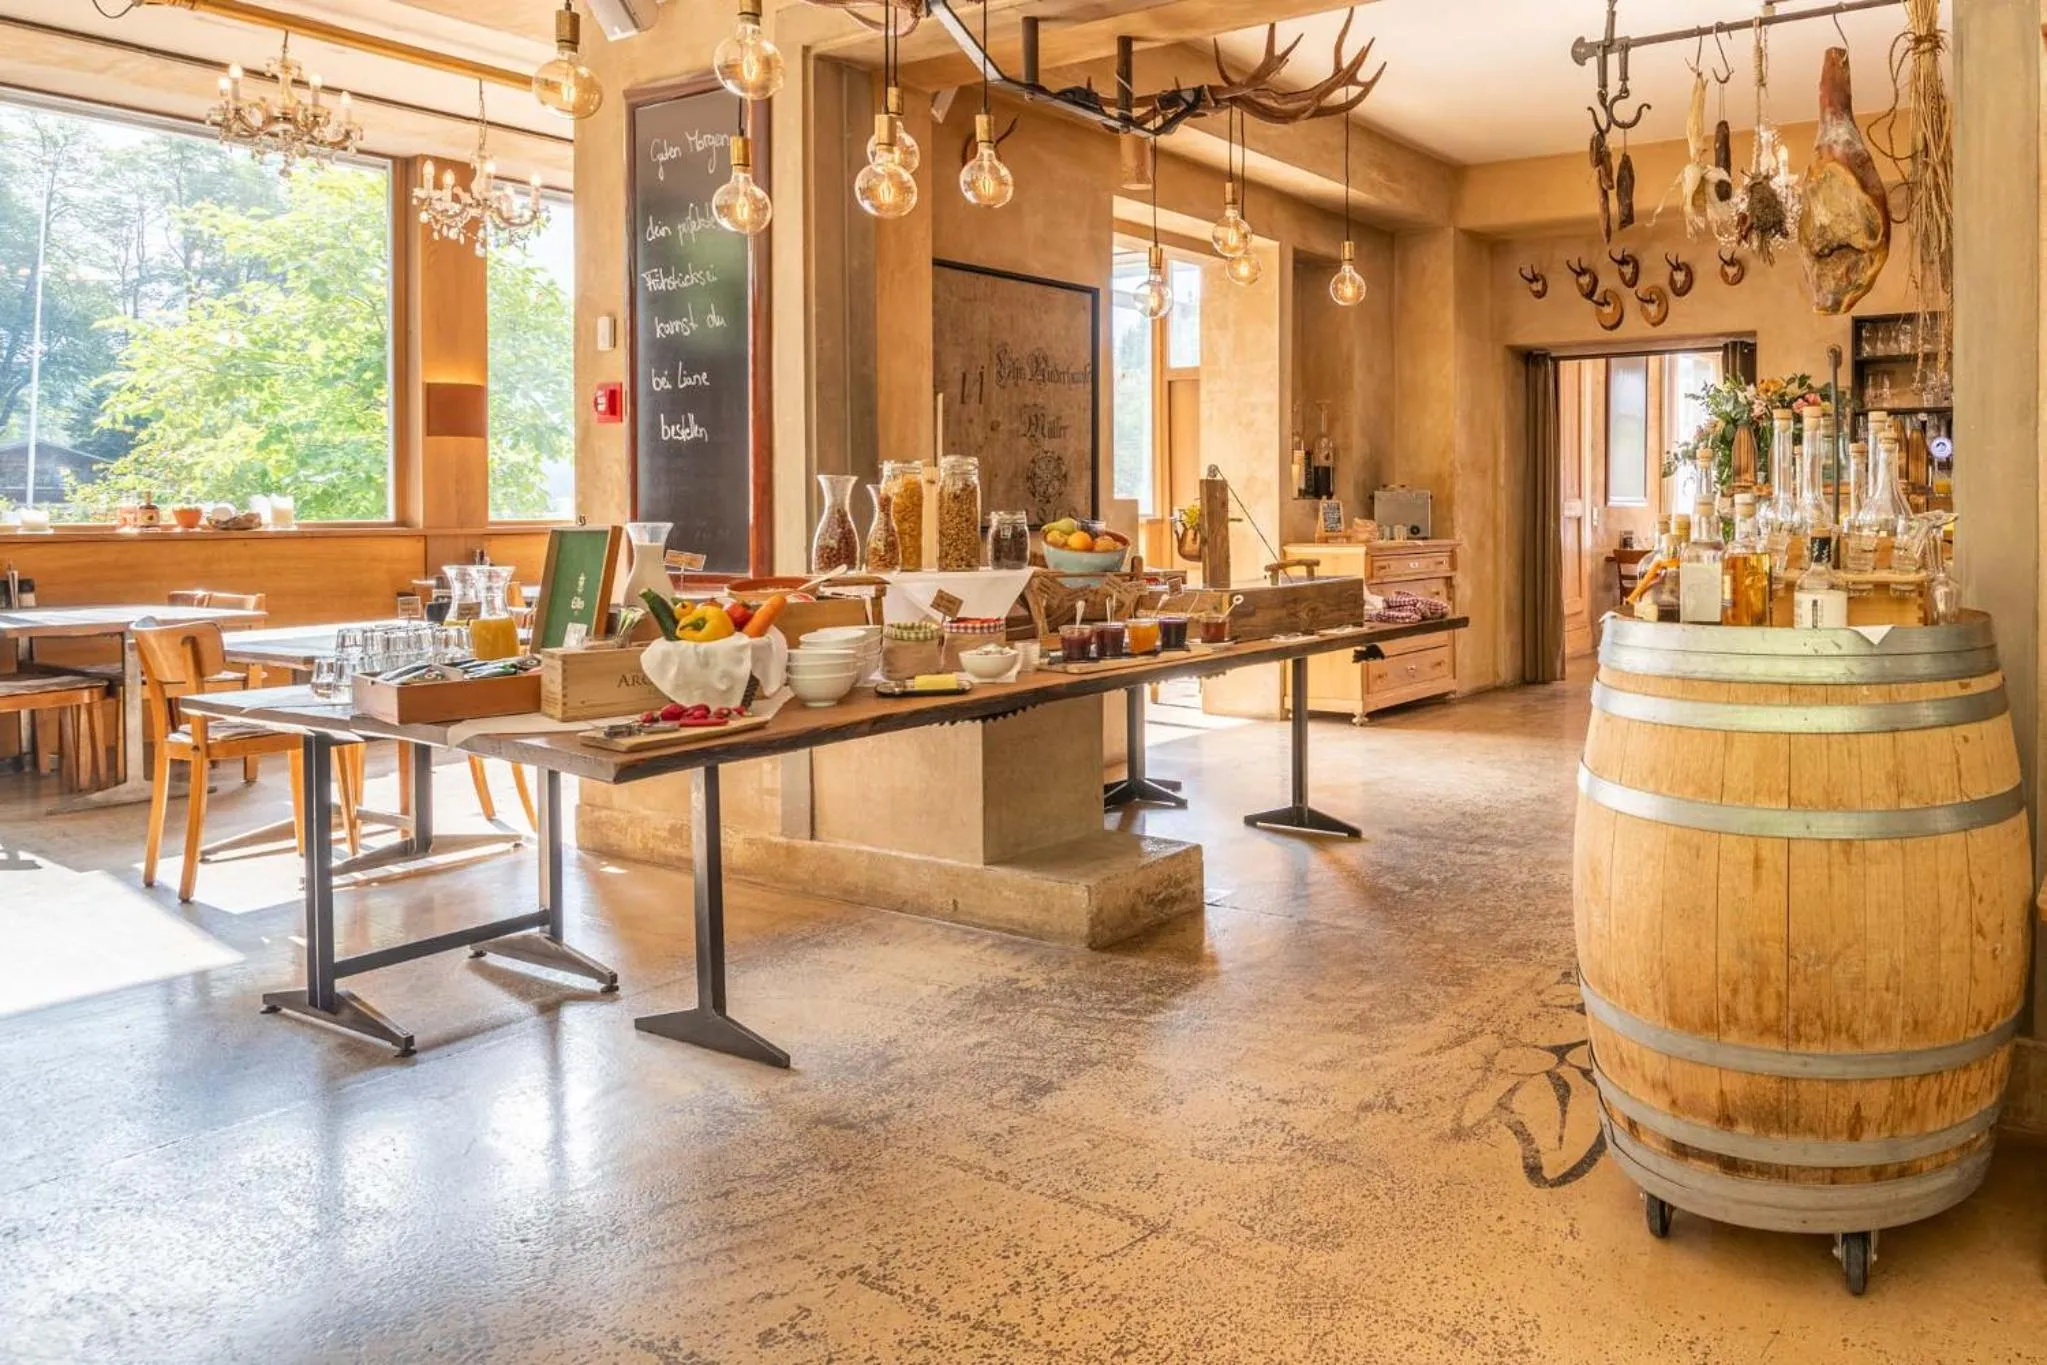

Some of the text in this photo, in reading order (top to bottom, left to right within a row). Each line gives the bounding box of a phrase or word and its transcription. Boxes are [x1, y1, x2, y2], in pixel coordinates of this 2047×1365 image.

[651, 128, 728, 182] Guten Morgen
[646, 215, 672, 241] dein
[706, 303, 727, 328] du
[652, 361, 710, 391] bei Liane
[660, 413, 708, 442] bestellen
